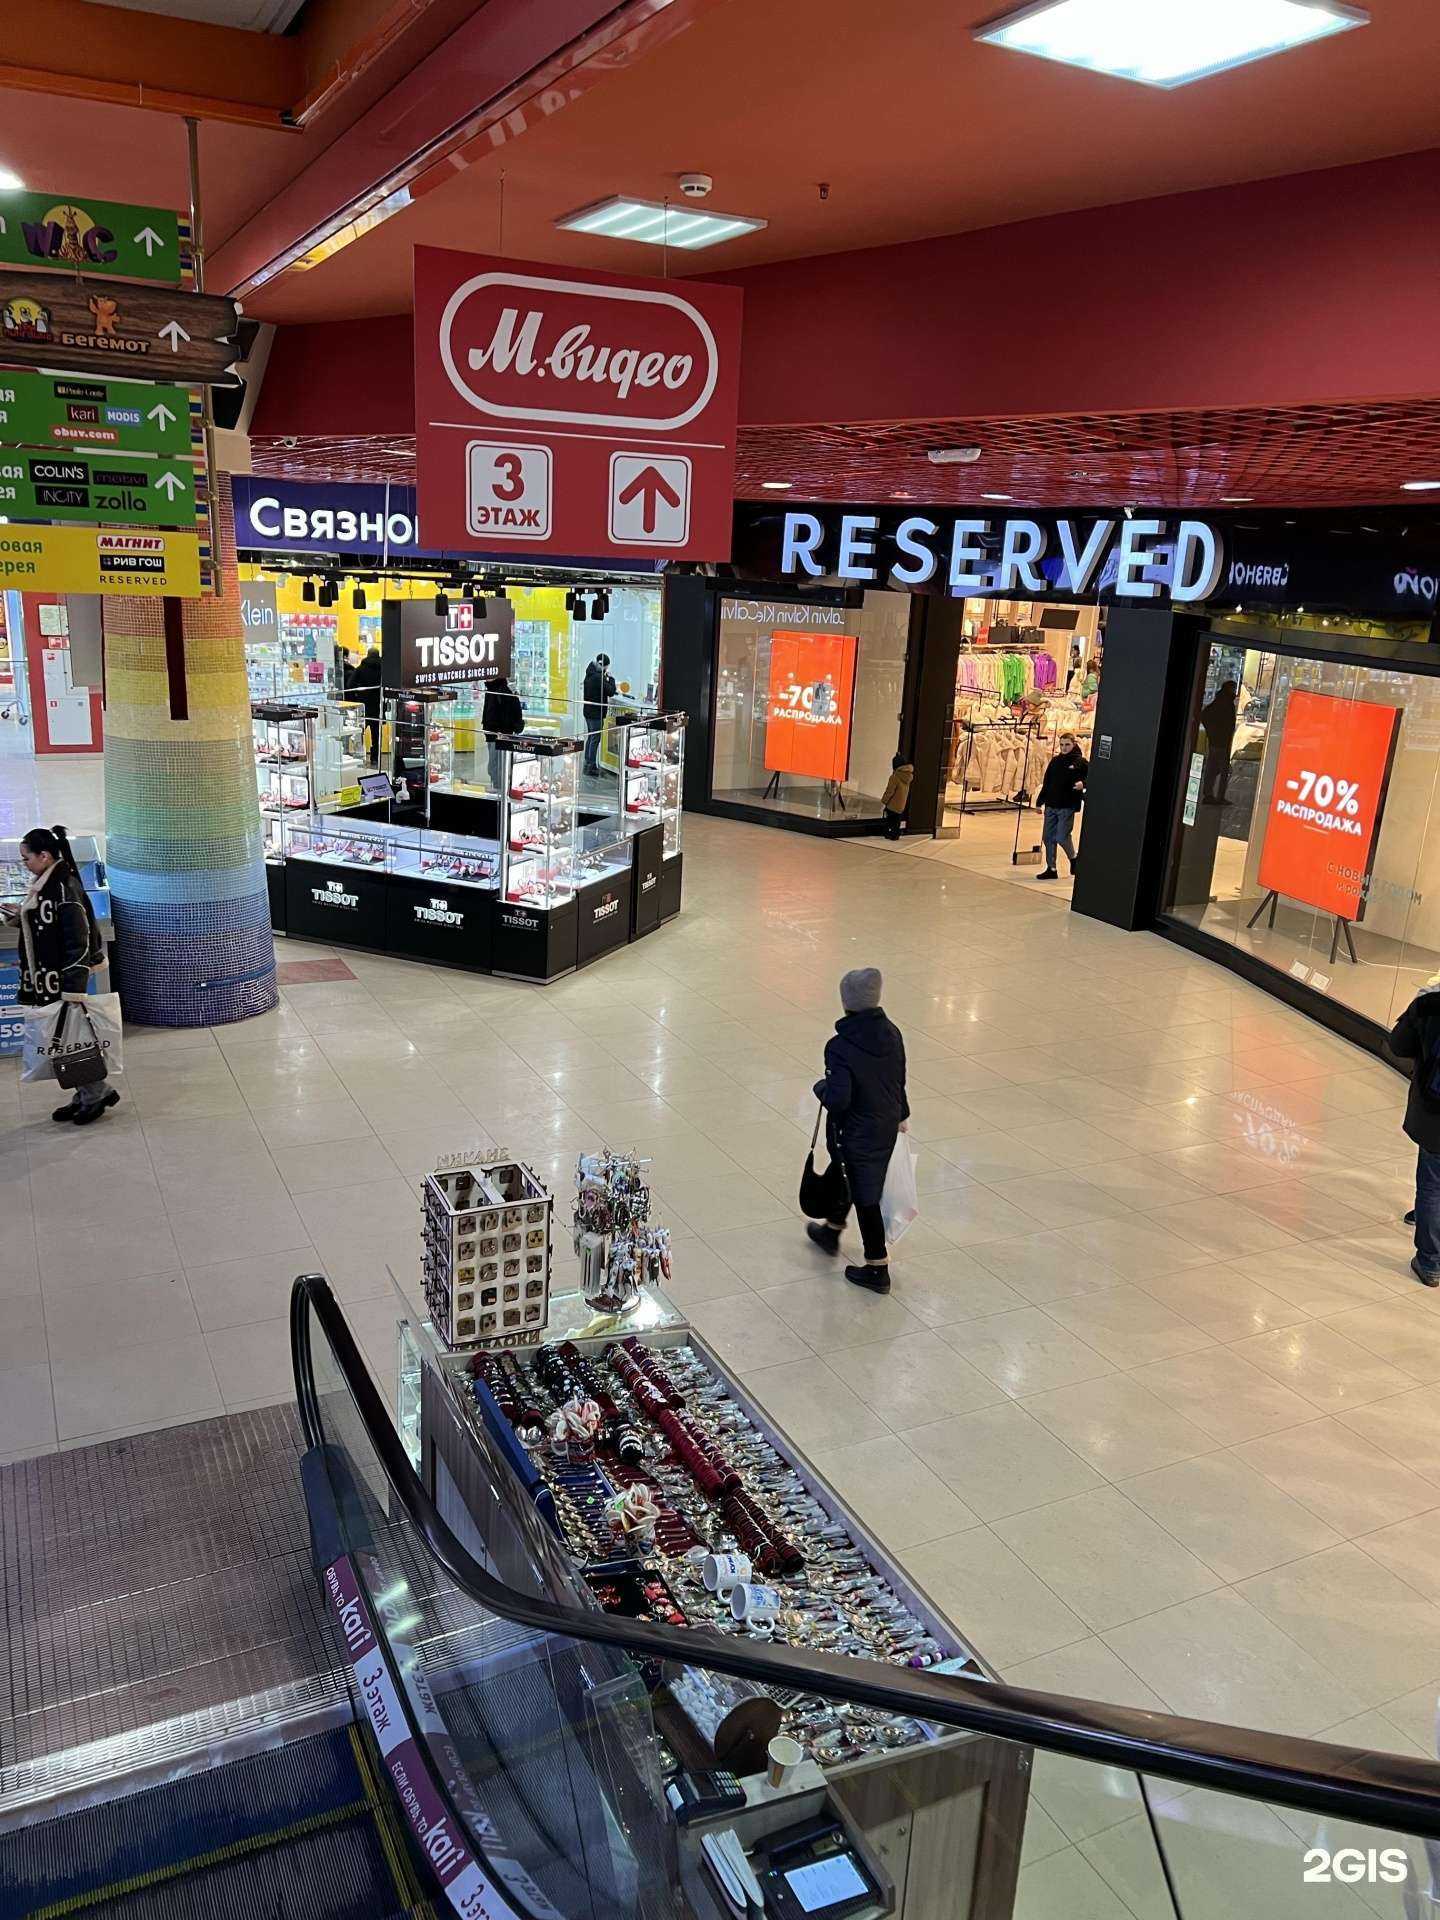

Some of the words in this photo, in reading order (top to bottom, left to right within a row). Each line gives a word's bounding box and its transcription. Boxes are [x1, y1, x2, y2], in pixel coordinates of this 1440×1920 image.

[70, 406, 95, 420] kari
[107, 411, 140, 423] MODIS
[53, 427, 115, 440] obuv.com
[34, 465, 84, 479] COLIN'S
[491, 452, 525, 502] 3
[94, 490, 147, 511] zolla
[250, 497, 418, 544] Связно
[477, 506, 541, 528] ЭТАЖ
[100, 537, 162, 549] МАГНИТ
[113, 557, 137, 566] РИВ
[138, 558, 162, 568] ГОШ
[781, 512, 1222, 601] RESERVED
[99, 575, 168, 586] RESERVED
[415, 633, 499, 667] TISSOT
[415, 674, 436, 684] SWISS
[437, 670, 466, 681] WATCHES
[467, 668, 485, 678] SINCE
[1286, 770, 1360, 816] -70%
[1276, 799, 1362, 837] РАСПРОДАЖА
[311, 889, 359, 907] TISSOT
[414, 906, 464, 925] TISSOT
[593, 899, 619, 919] TISSOT
[502, 915, 539, 928] TISSOT
[339, 1596, 372, 1651] kari
[362, 1667, 383, 1688] 3
[366, 1687, 391, 1733] этаж
[392, 1761, 409, 1789] ЕСЛИ
[416, 1816, 428, 1834] ТО
[422, 1817, 465, 1876] kari
[461, 1884, 484, 1908] 3
